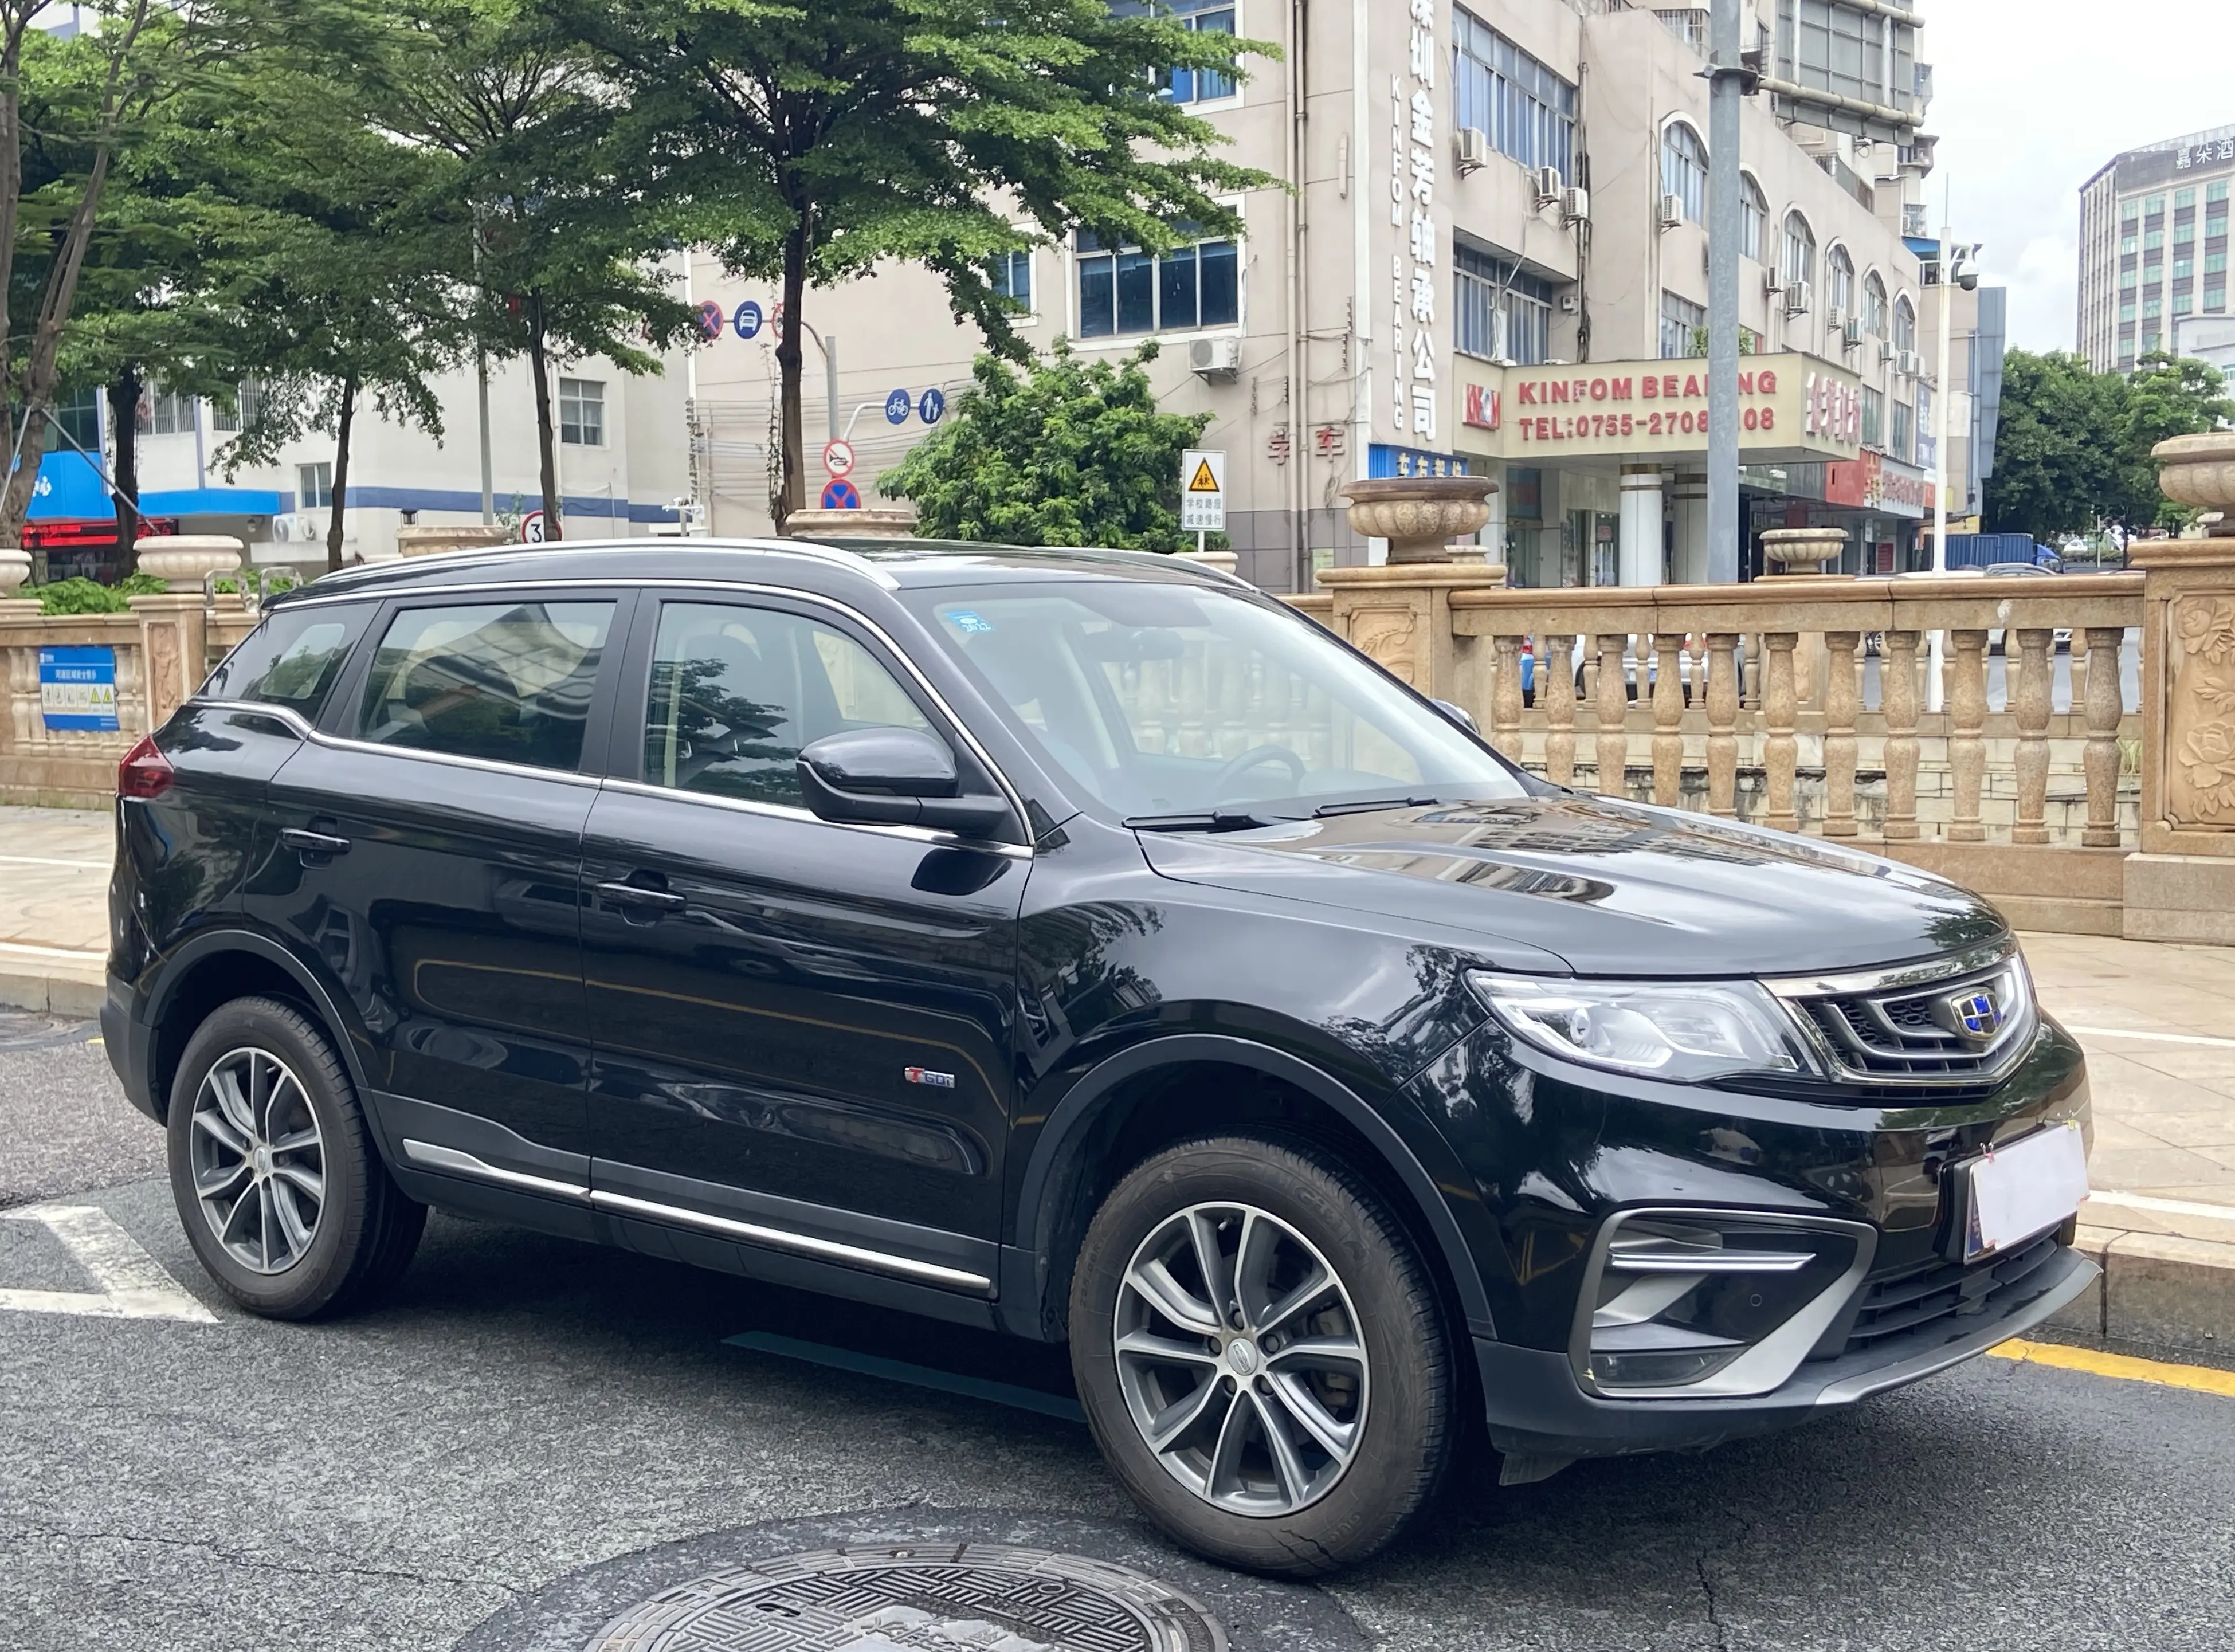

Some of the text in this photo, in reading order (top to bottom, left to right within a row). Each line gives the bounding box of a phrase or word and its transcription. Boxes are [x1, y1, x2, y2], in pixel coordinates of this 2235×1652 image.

[1390, 73, 1403, 430] KINFOM BEARING
[1519, 370, 1776, 404] KINFOM BEANG
[1519, 407, 1774, 441] TEL:0755-270808
